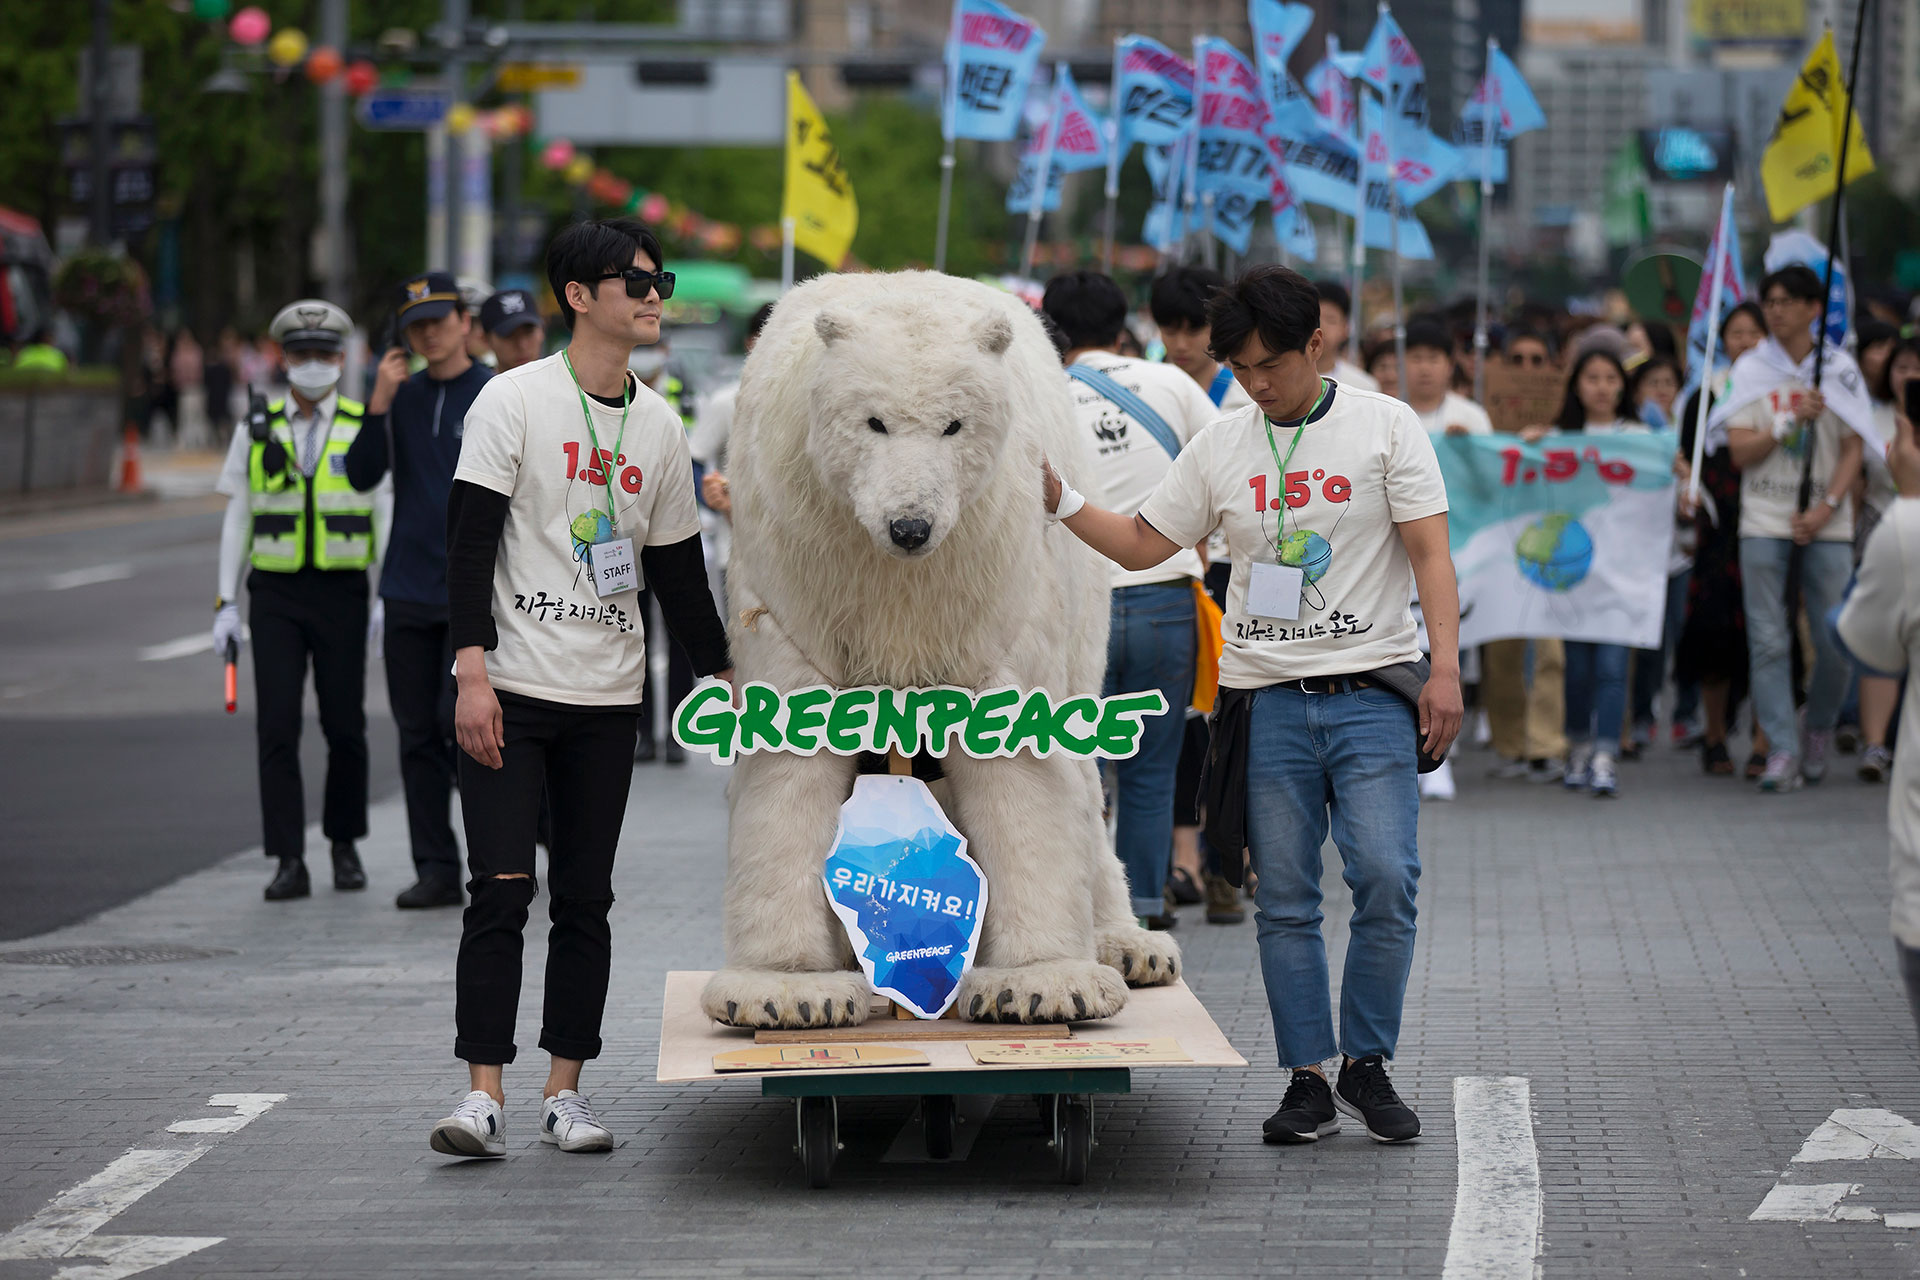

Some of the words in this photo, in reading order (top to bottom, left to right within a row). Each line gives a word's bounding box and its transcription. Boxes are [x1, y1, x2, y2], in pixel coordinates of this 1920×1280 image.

[603, 563, 631, 580] STAFF
[677, 685, 1163, 758] GREENPEACE
[885, 944, 953, 964] GREENPEACE
